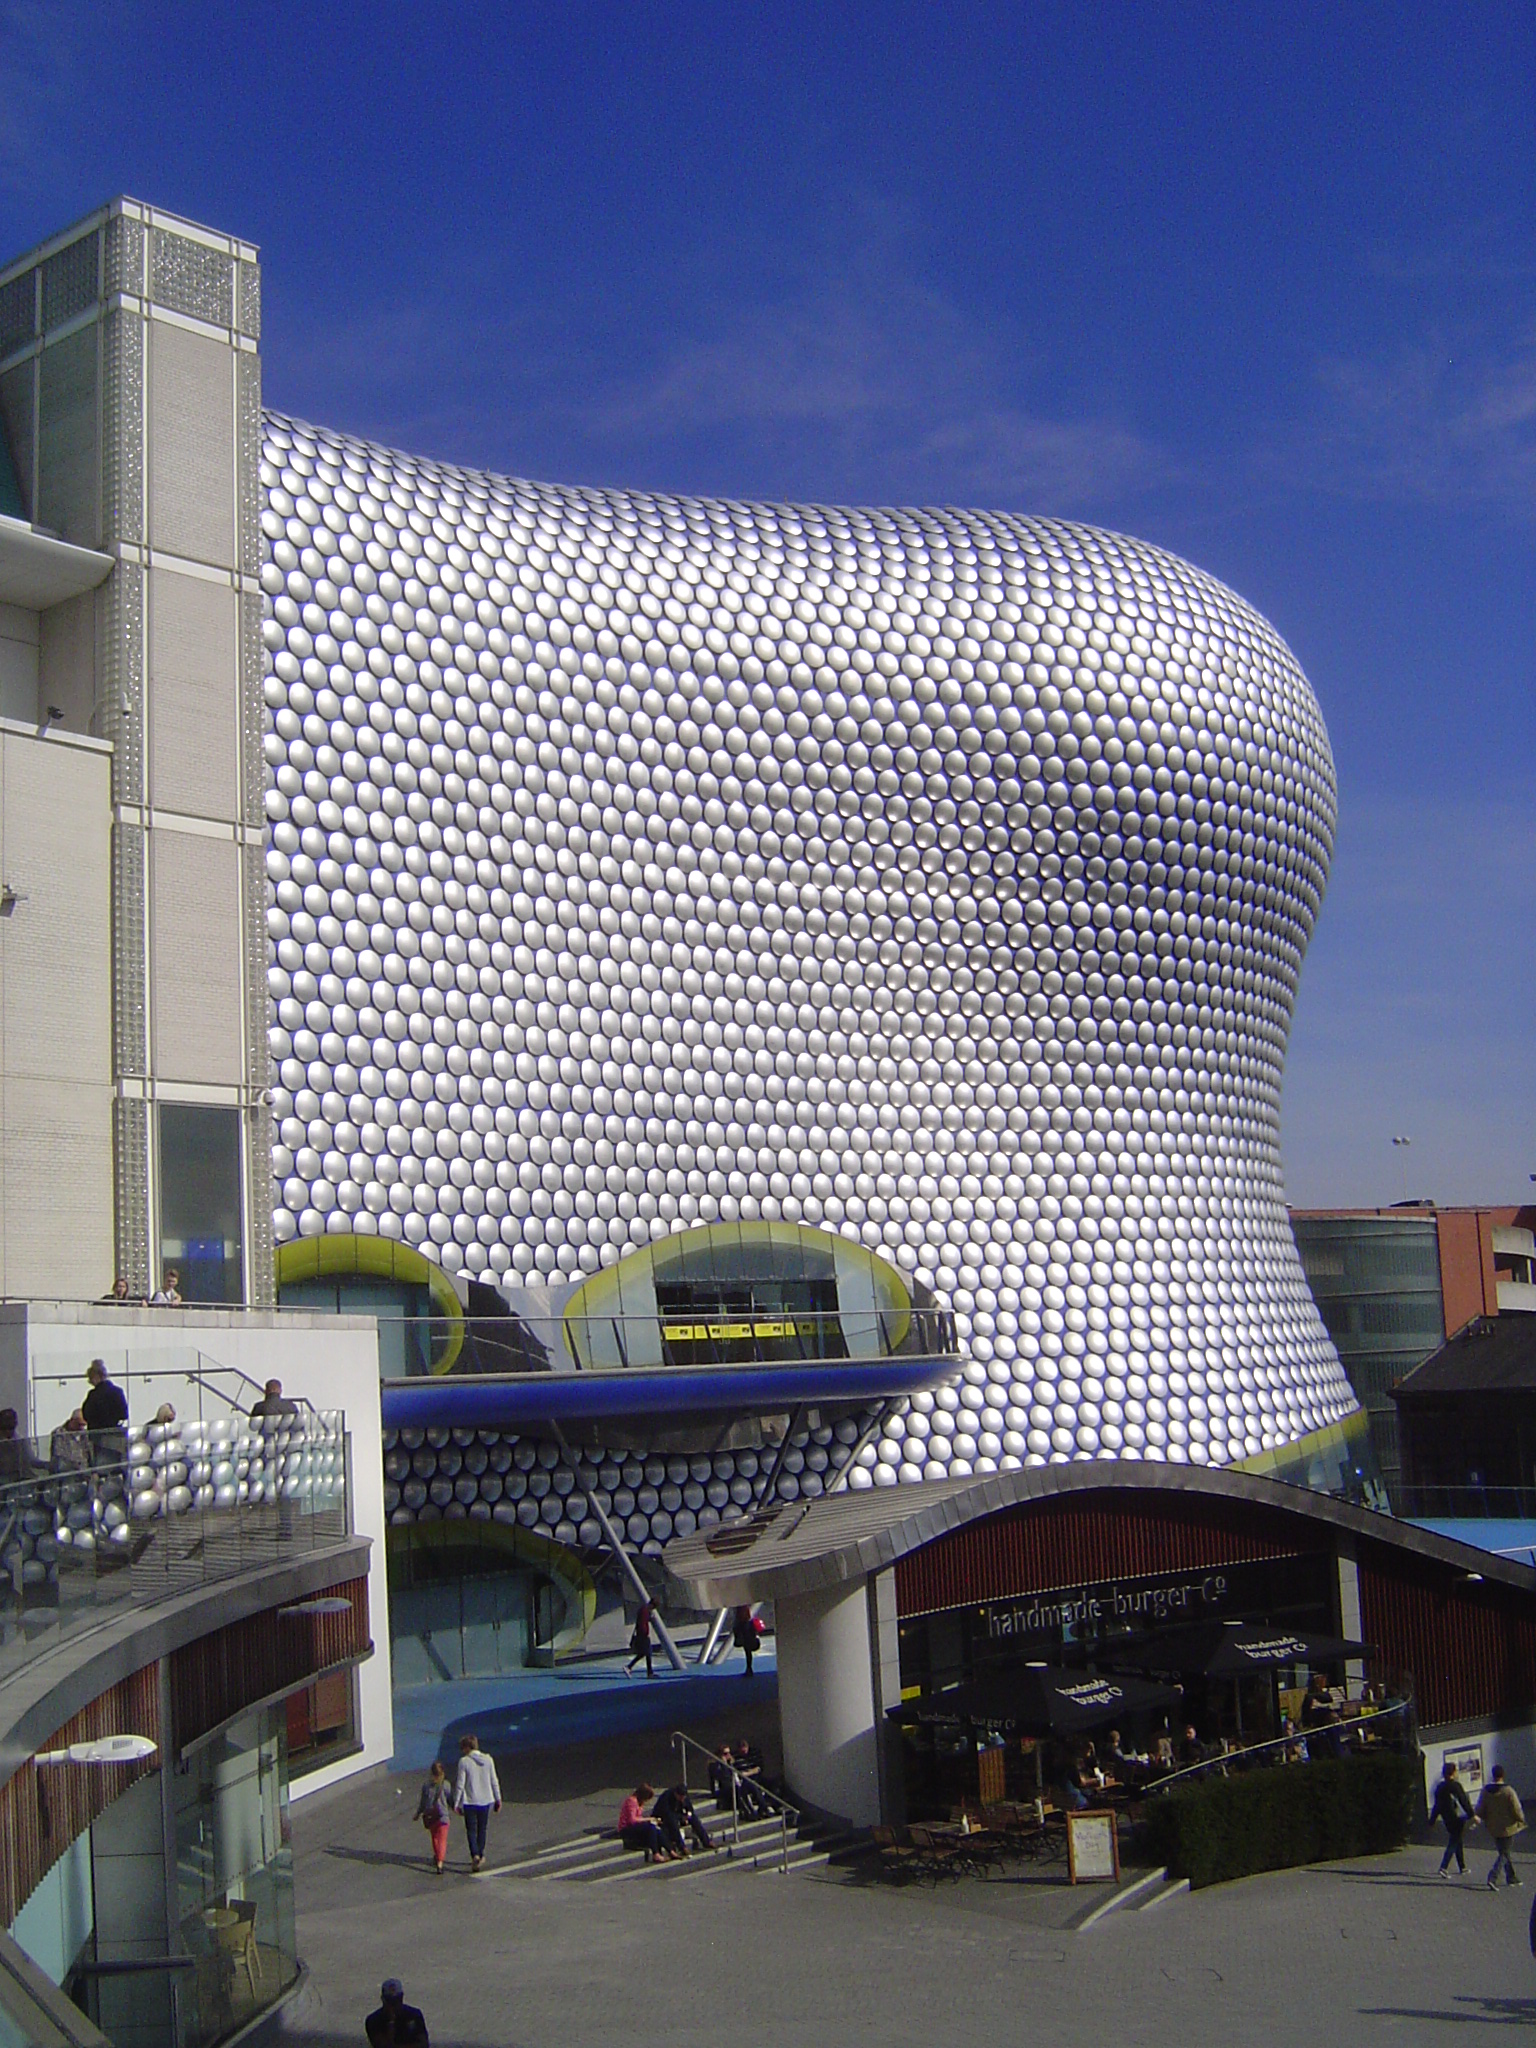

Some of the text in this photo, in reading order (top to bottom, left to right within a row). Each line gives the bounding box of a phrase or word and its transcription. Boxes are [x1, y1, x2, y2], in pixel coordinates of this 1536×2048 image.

[987, 1590, 1102, 1638] handmade
[1113, 1586, 1190, 1617] burger
[1234, 1636, 1298, 1651] handmade
[1246, 1648, 1293, 1659] burger
[1070, 1692, 1113, 1705] burger
[970, 1714, 1003, 1730] burger
